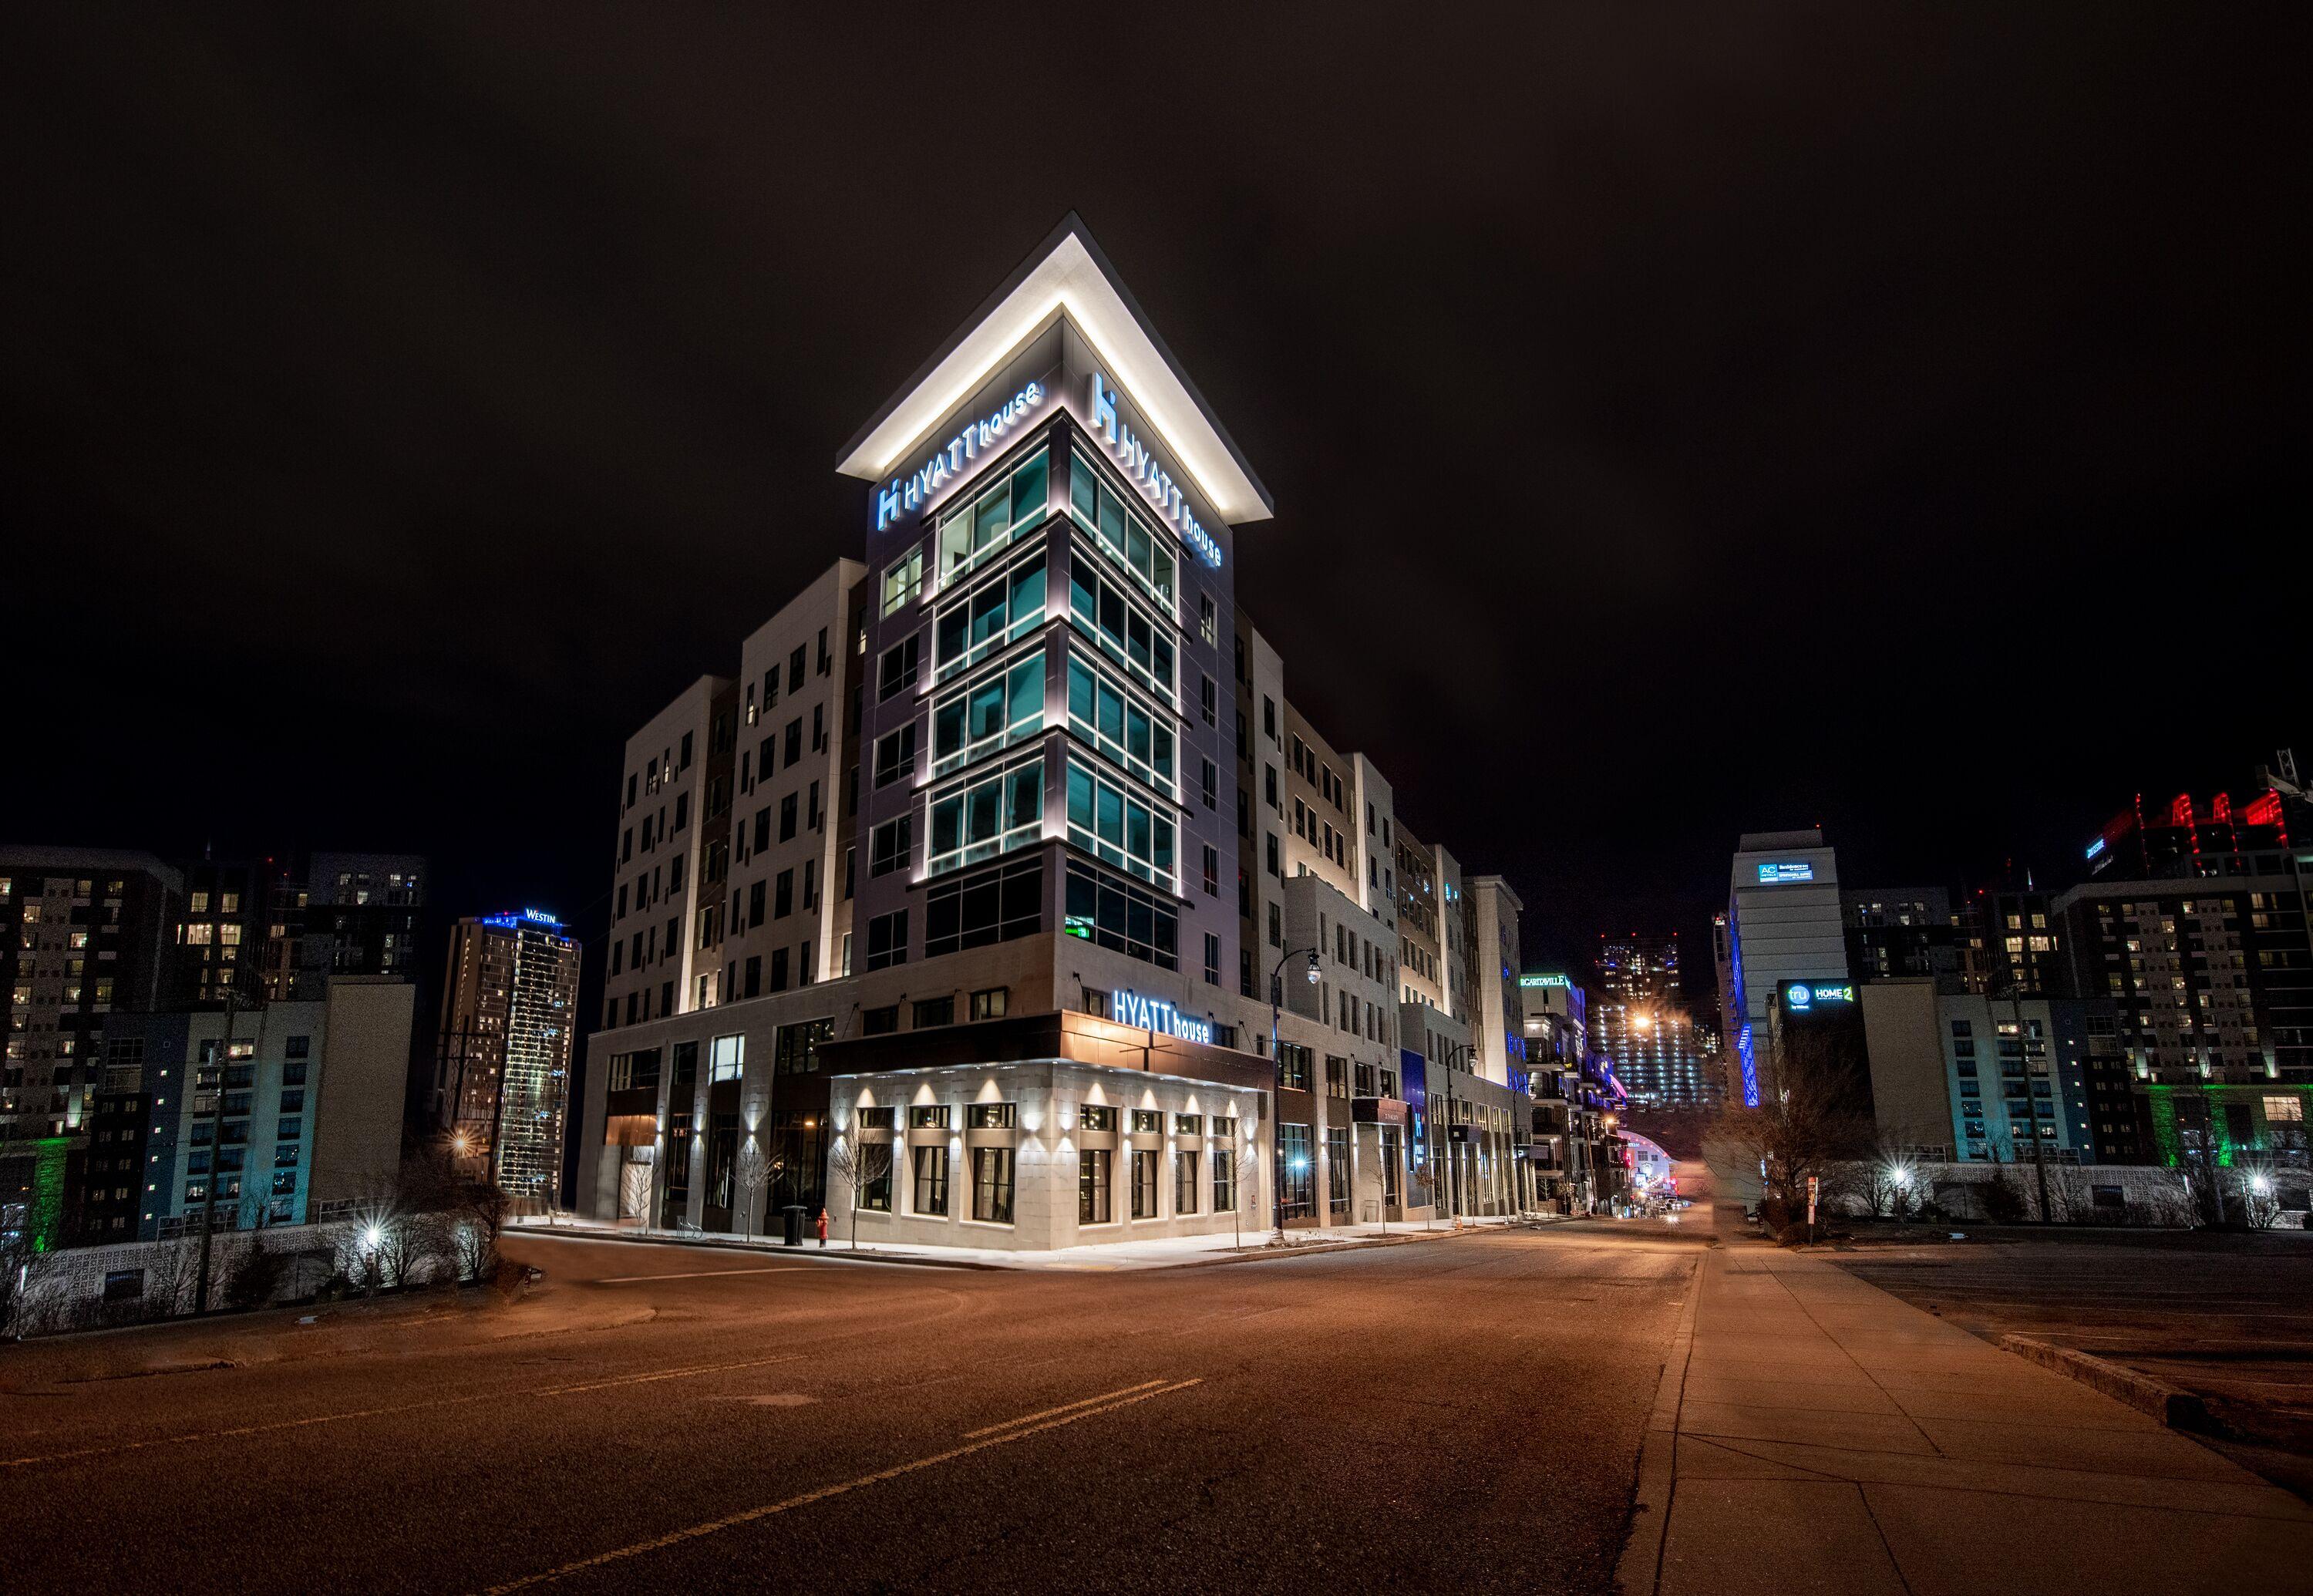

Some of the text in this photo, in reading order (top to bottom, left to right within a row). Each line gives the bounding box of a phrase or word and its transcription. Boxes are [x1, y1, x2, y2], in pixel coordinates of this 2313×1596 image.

[904, 424, 977, 510] HYATT
[979, 382, 1042, 446] house
[1120, 424, 1182, 520] HYATT
[1183, 504, 1221, 566] house
[526, 908, 556, 924] WESTIN
[1114, 990, 1209, 1044] HYATT house
[1788, 989, 1807, 1000] tru
